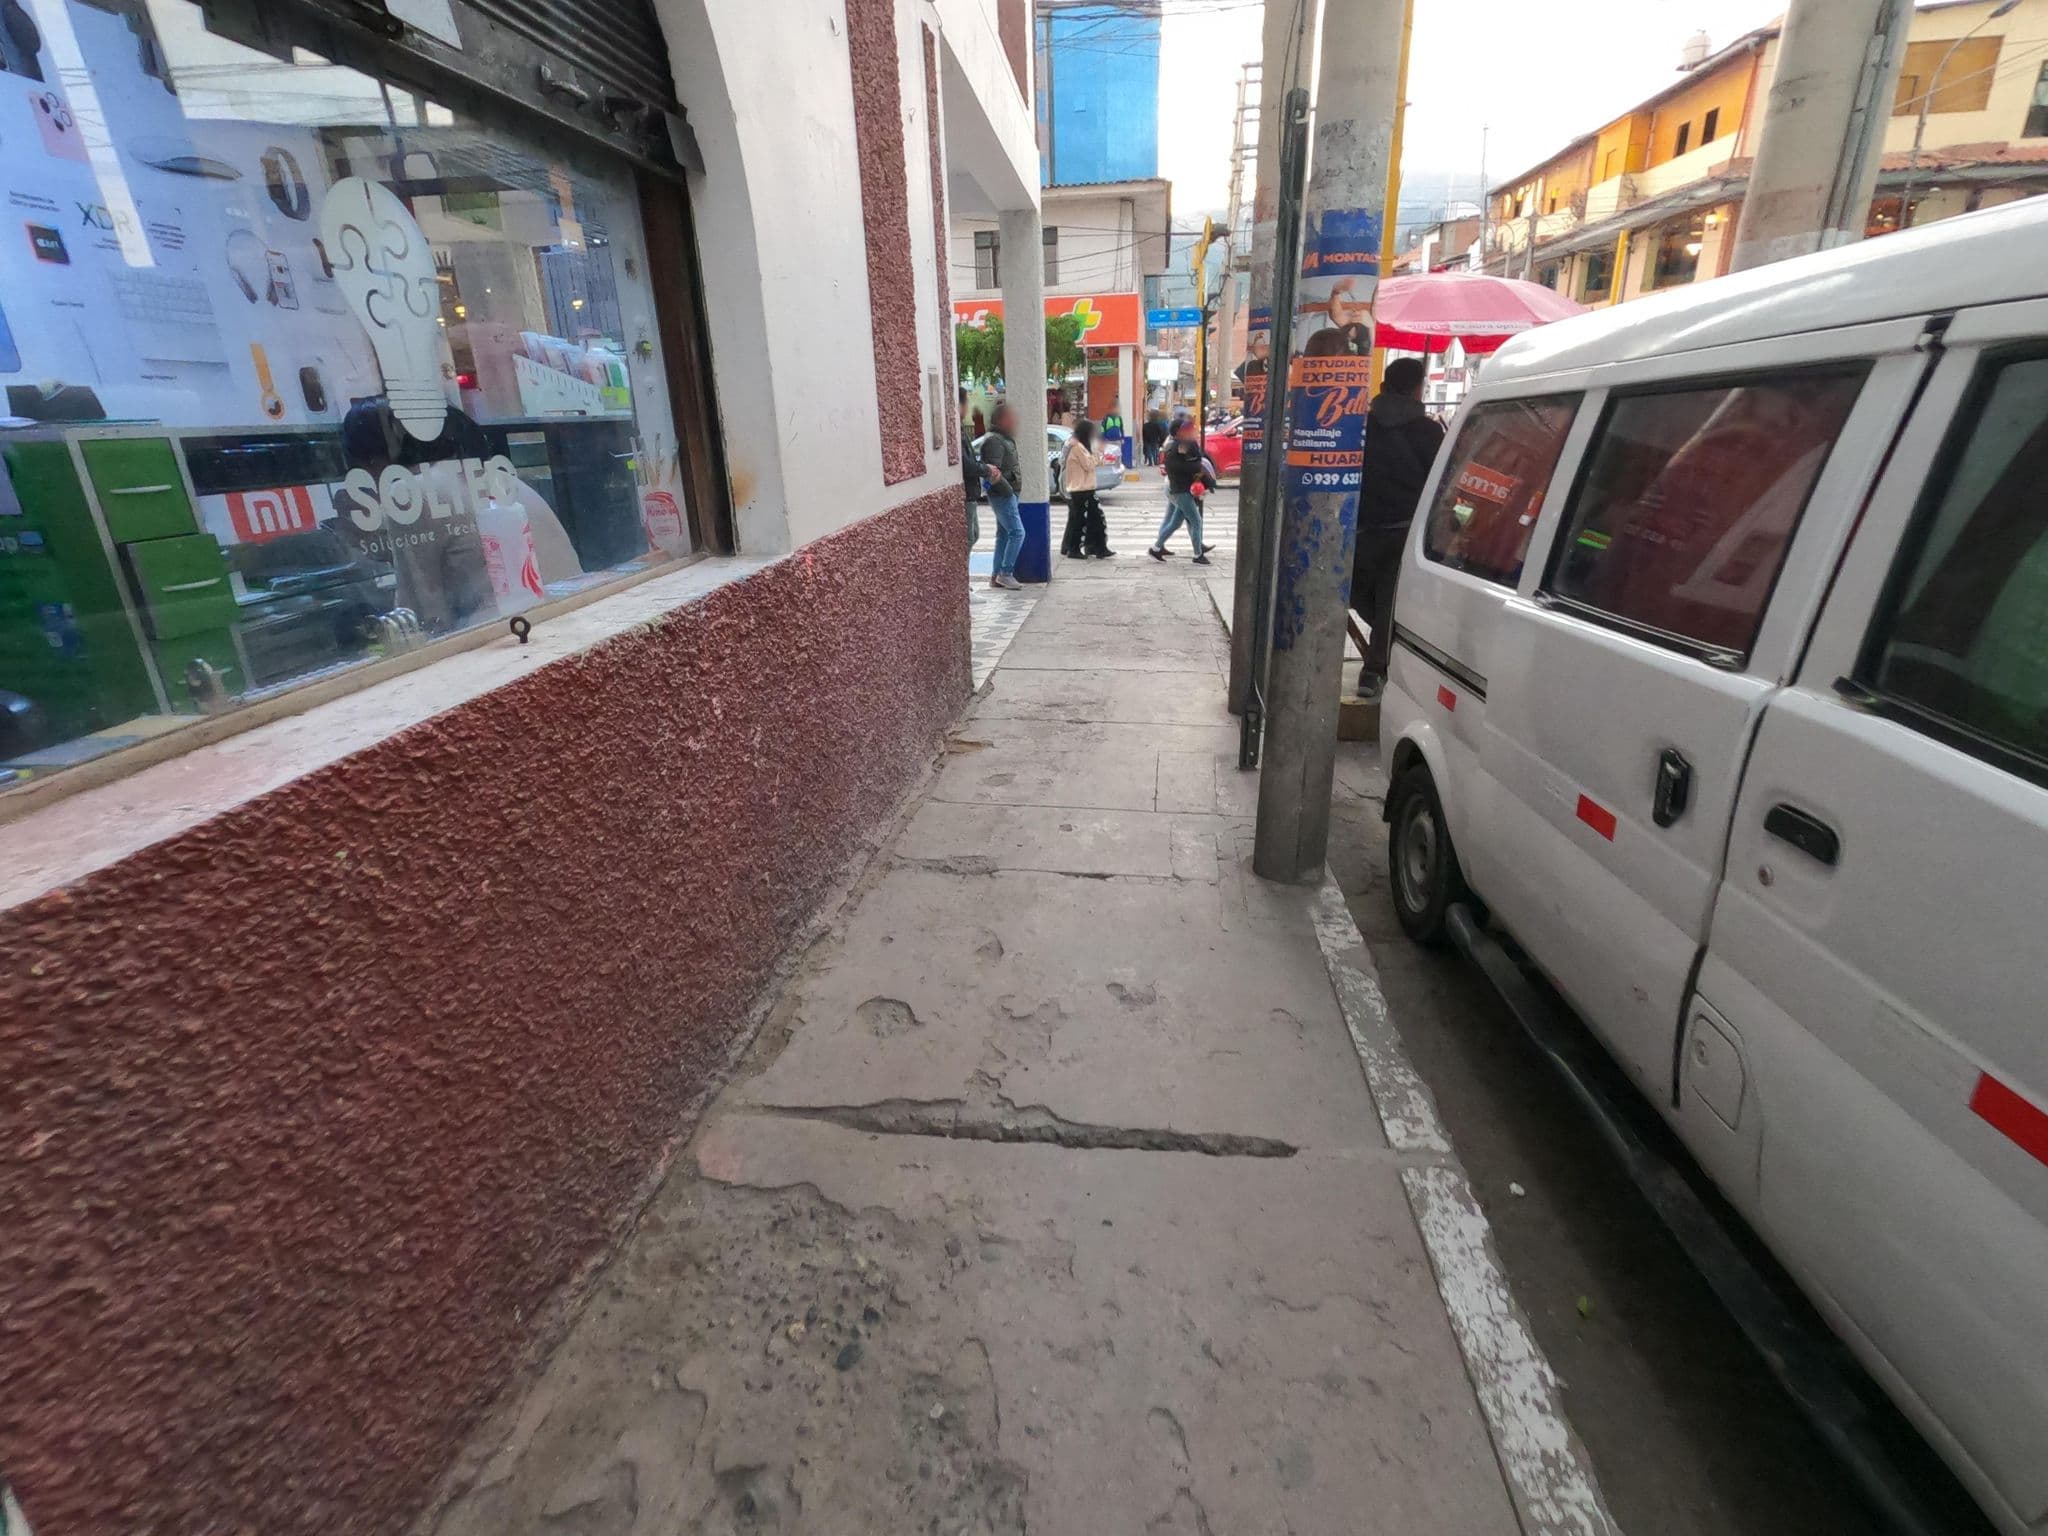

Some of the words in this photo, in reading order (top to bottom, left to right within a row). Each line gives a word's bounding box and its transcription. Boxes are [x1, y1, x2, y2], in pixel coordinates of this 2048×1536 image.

[1303, 360, 1356, 369] ESTUDIA
[1293, 439, 1337, 448] Estilismo
[1313, 472, 1340, 485] 939
